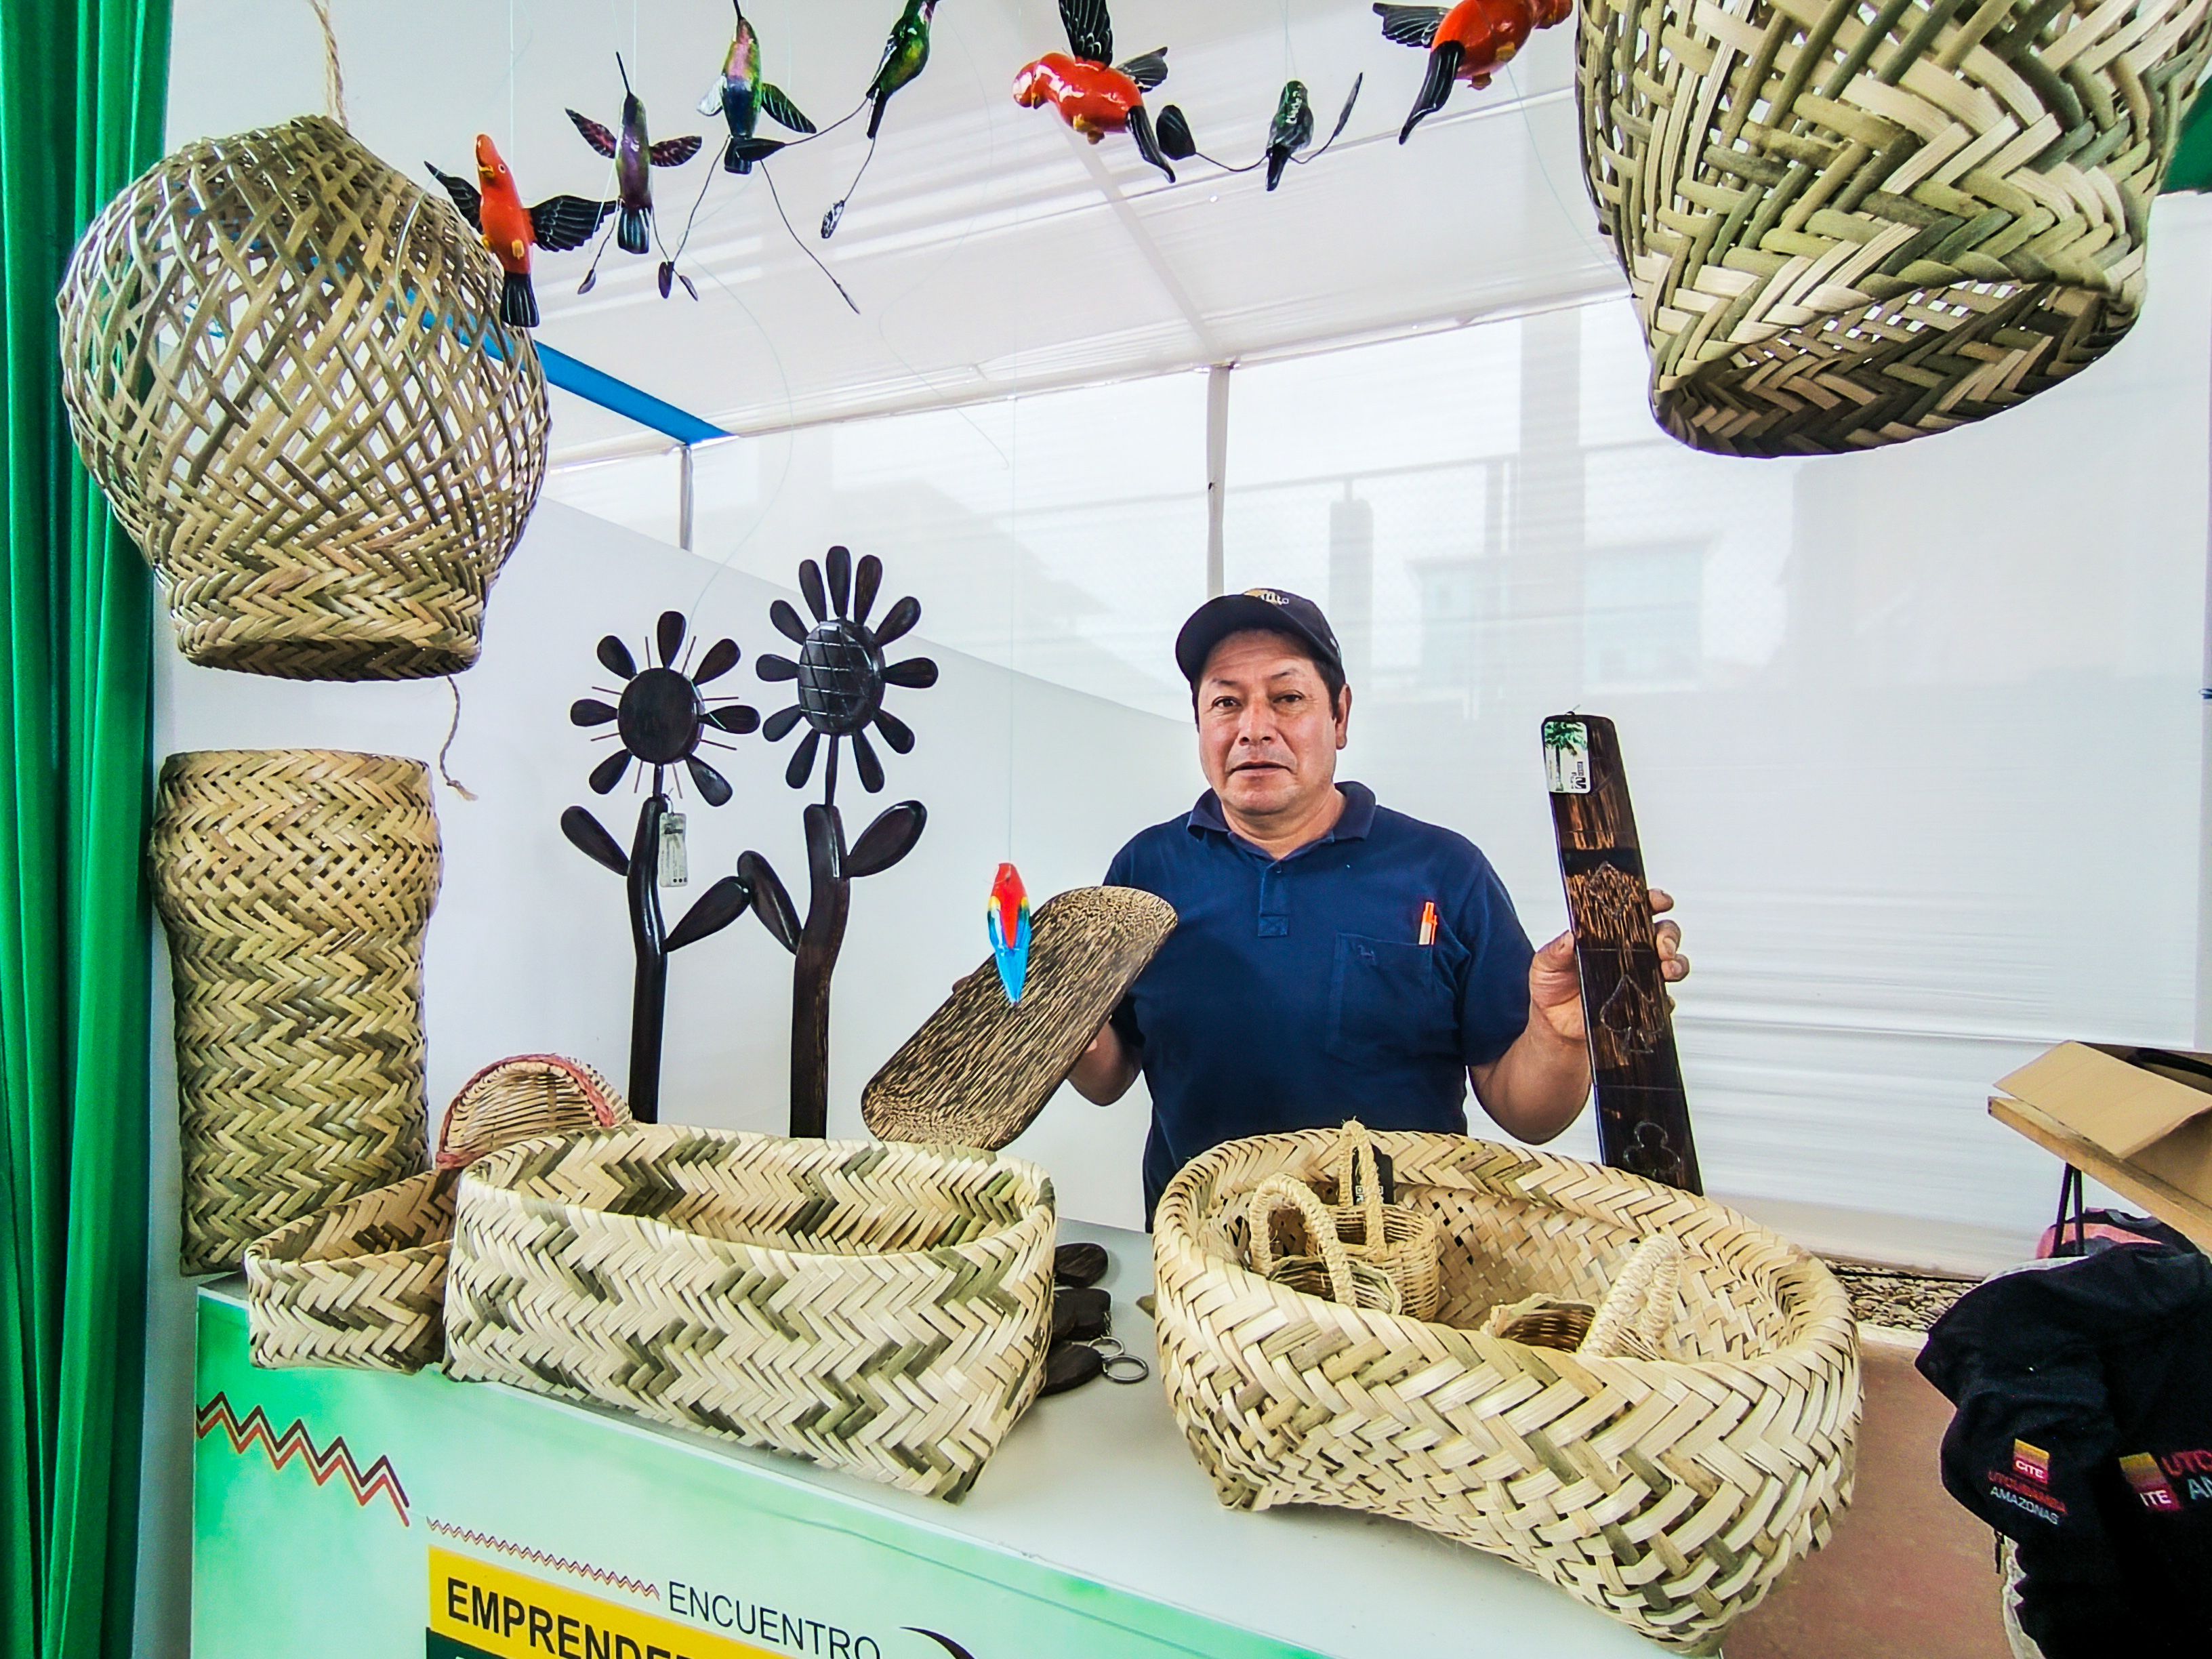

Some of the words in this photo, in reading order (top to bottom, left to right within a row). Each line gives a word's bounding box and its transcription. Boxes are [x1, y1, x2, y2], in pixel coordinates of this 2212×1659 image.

[2015, 1460, 2045, 1479] CITE
[1989, 1486, 2060, 1525] AMAZONAS
[2139, 1490, 2172, 1507] ITE
[669, 1580, 880, 1659] ENCUENTRO
